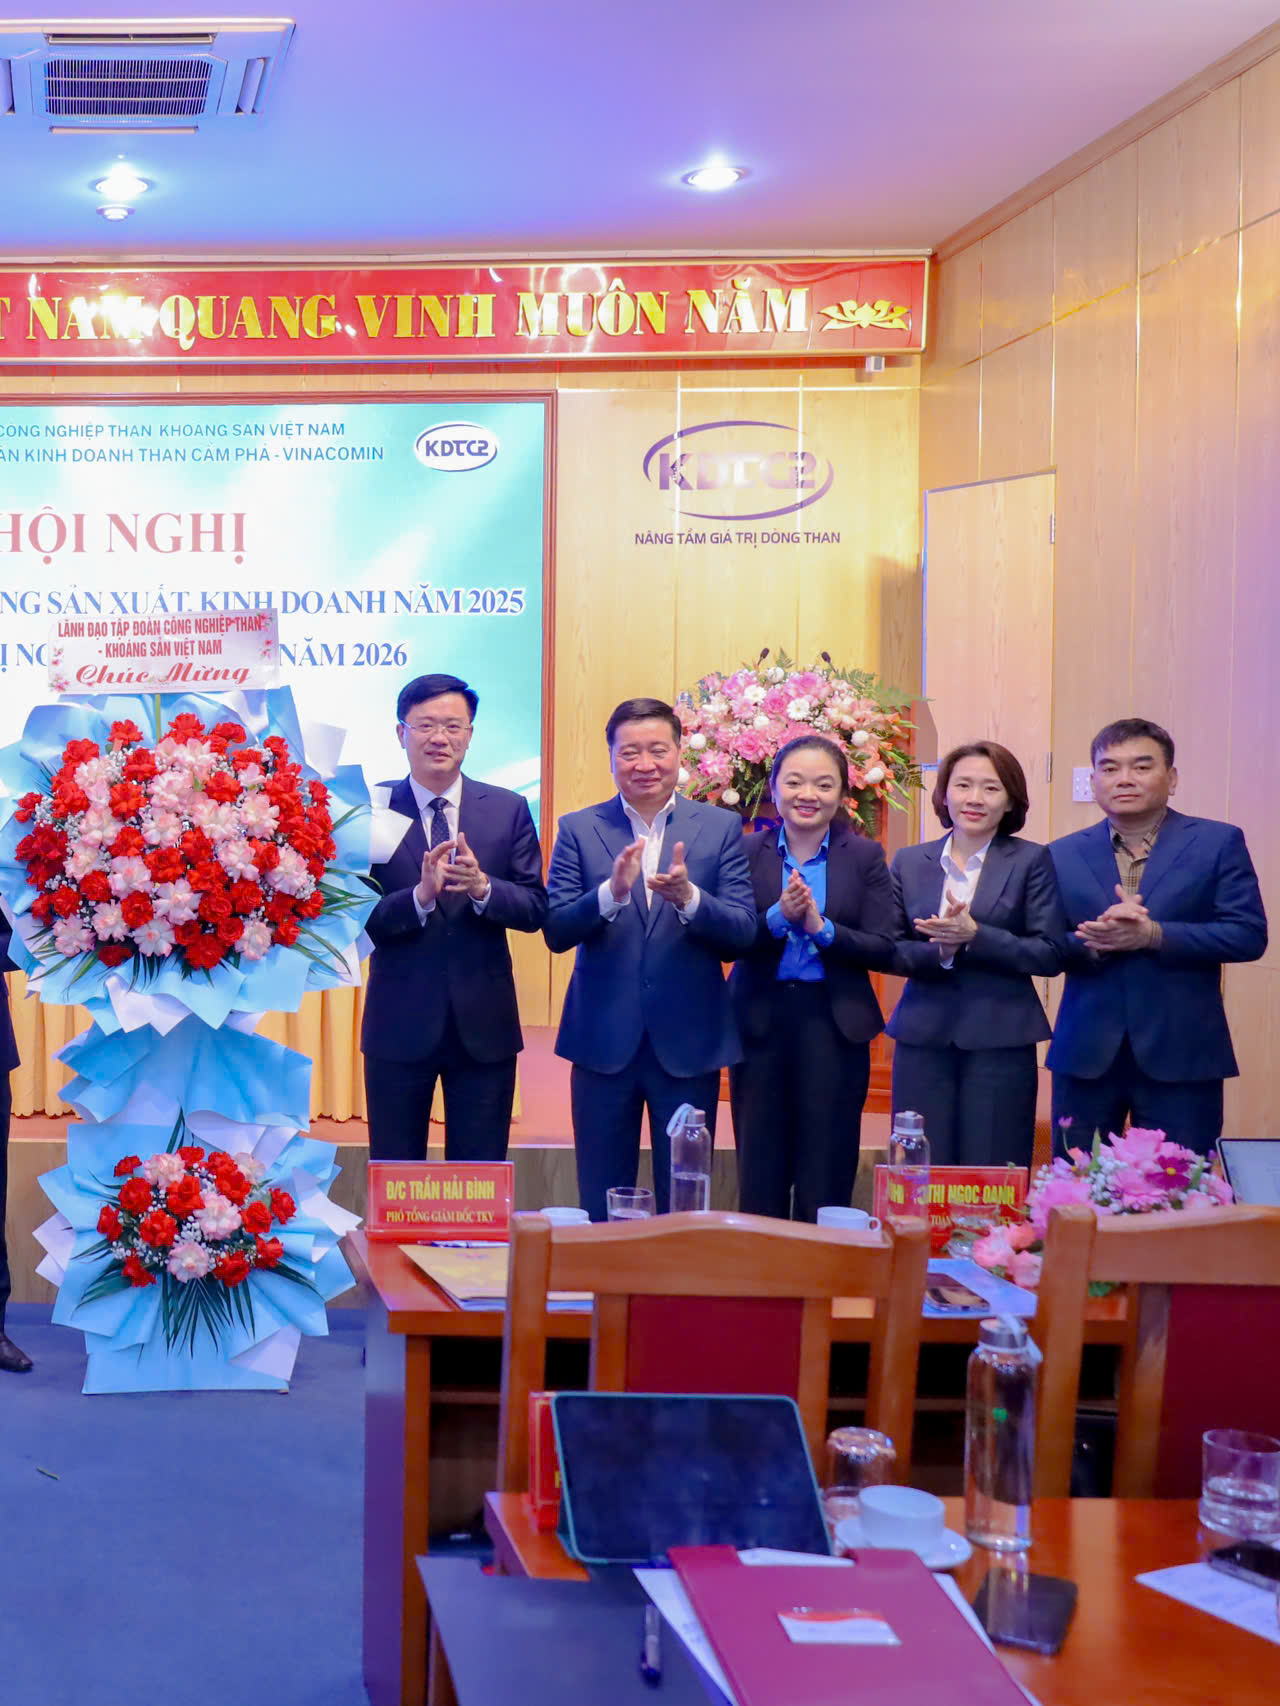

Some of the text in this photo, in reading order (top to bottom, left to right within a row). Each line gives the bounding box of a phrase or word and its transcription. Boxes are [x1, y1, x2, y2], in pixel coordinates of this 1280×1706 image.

[25, 295, 146, 341] NAM
[159, 293, 338, 351] QUANG
[355, 294, 497, 338] VINH
[515, 277, 669, 338] MUÔN
[684, 278, 809, 334] NĂM
[108, 424, 152, 438] THAN
[308, 422, 345, 436] NAM
[25, 448, 67, 462] KINH
[72, 448, 134, 462] DOANH
[138, 447, 187, 462] THAN
[283, 446, 384, 462] VINACOMIN
[106, 512, 247, 565] NGHỊ
[736, 532, 758, 549] TRỊ
[804, 532, 841, 544] THAN
[280, 590, 386, 614] DOANH
[393, 584, 462, 614] NĂM
[467, 590, 525, 614] 2025
[198, 639, 222, 656] NAM
[279, 636, 345, 666] NĂM
[352, 642, 409, 667] 2026
[75, 662, 251, 685] Chúc Mừng
[385, 1180, 406, 1200] Đ/C
[982, 1185, 1016, 1205] OANH
